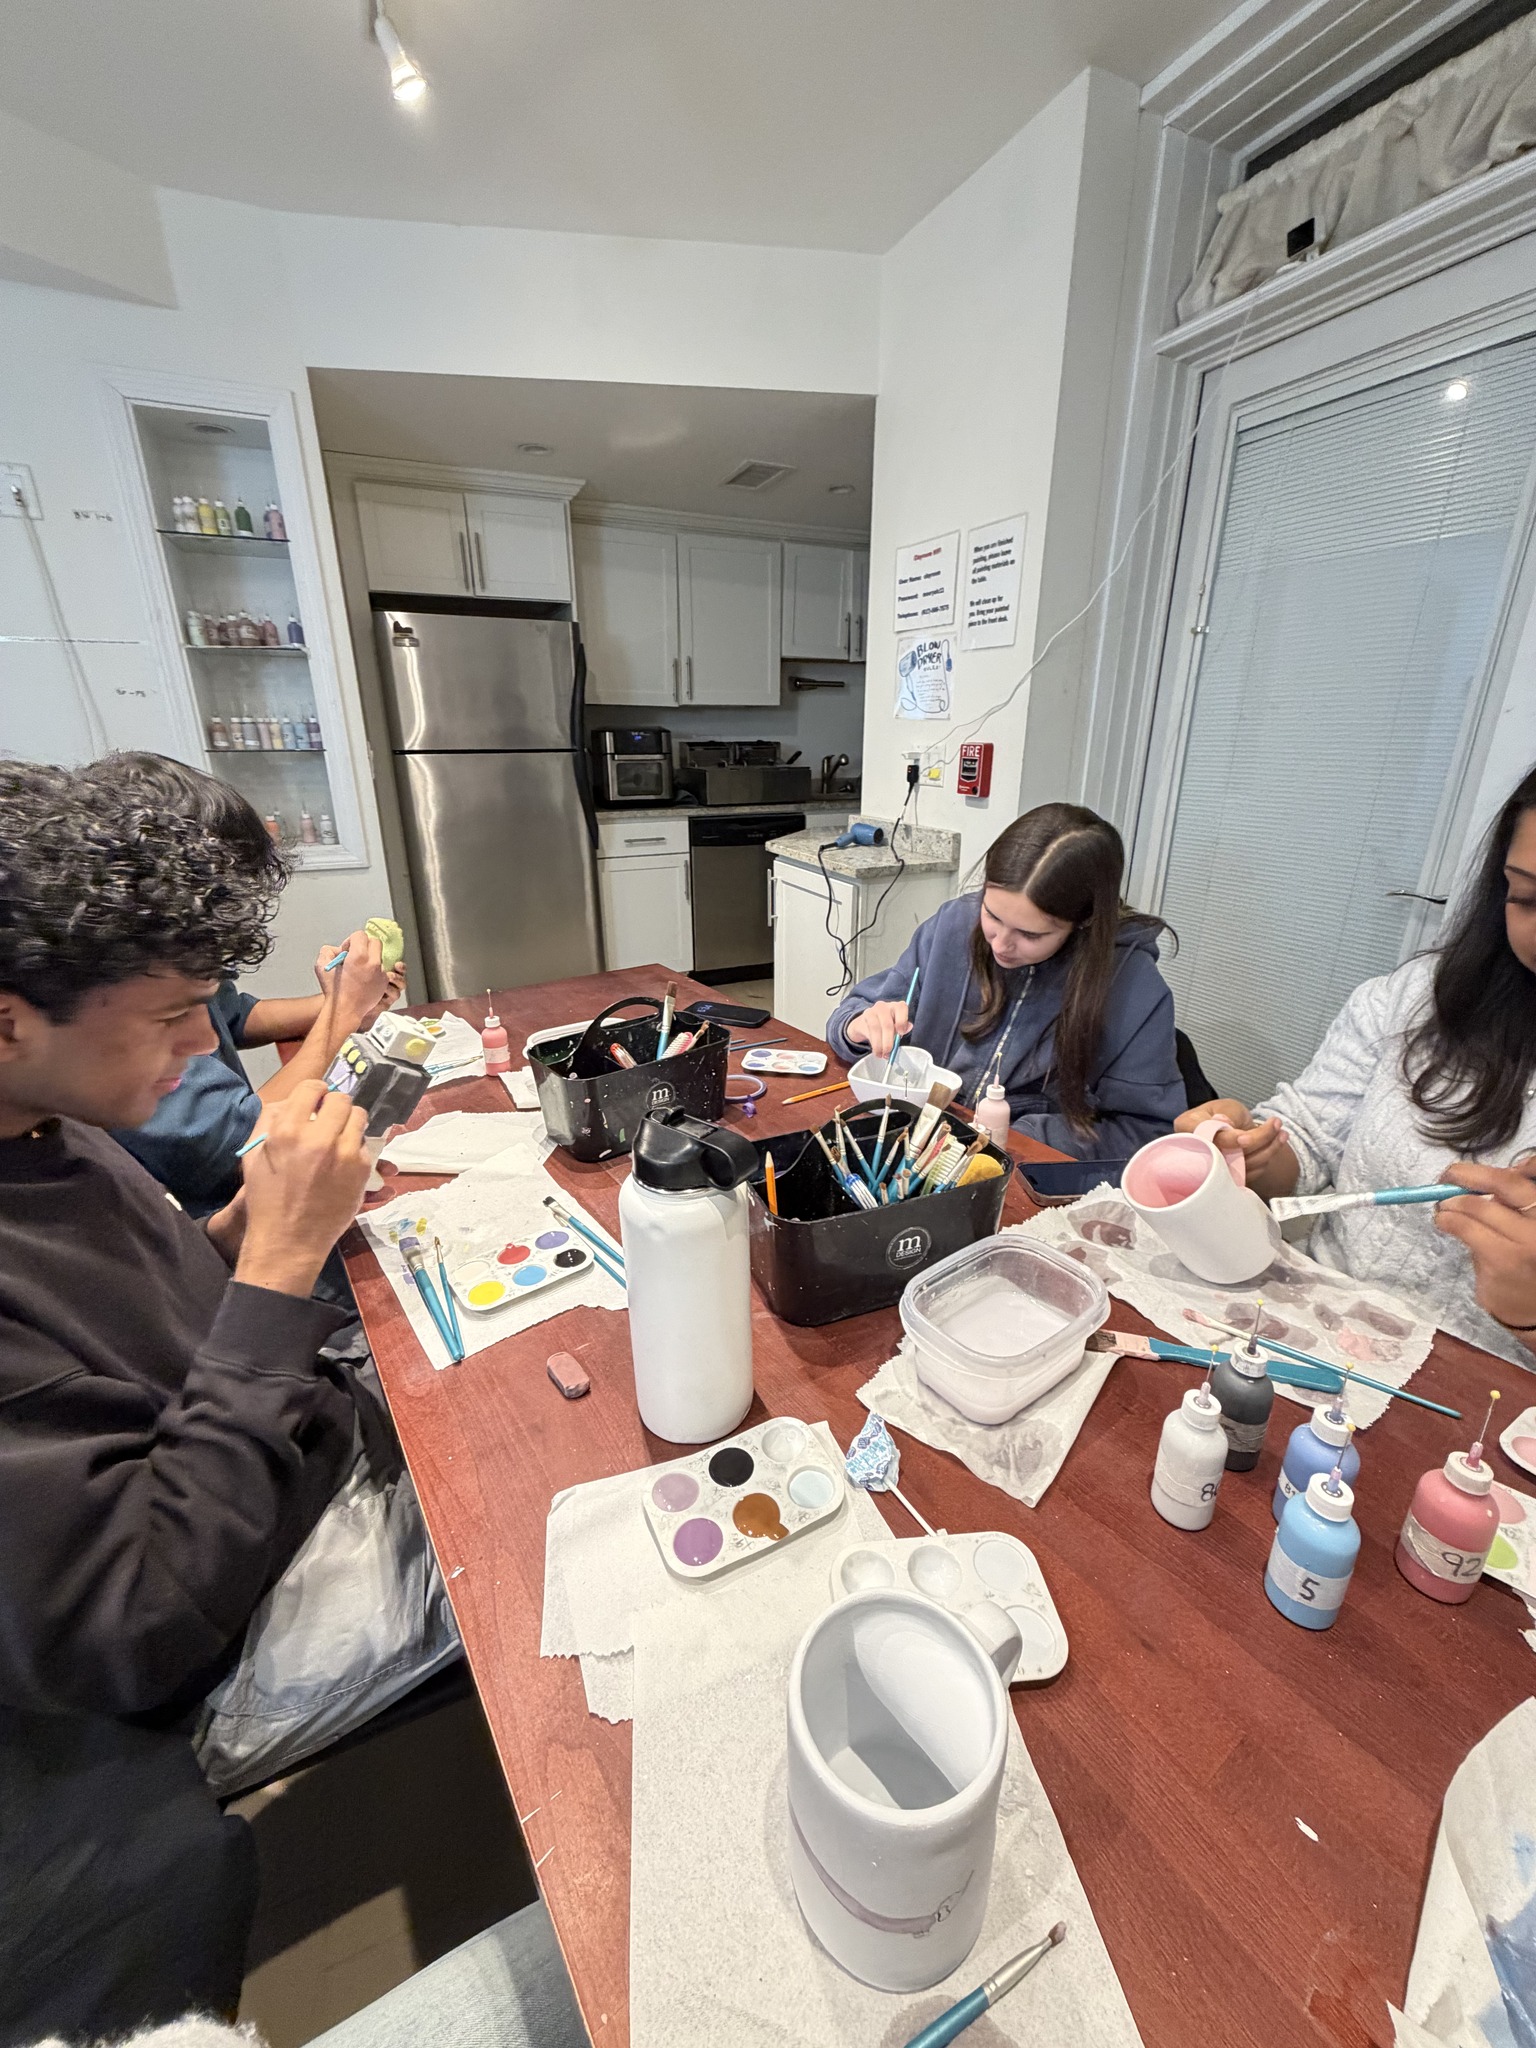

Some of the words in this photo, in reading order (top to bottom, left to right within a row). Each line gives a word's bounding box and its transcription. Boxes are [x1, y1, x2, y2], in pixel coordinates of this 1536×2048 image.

[917, 652, 942, 670] DRYER
[962, 745, 980, 757] FIRE
[652, 1088, 669, 1100] m
[897, 1235, 921, 1252] m
[895, 1247, 921, 1258] DESIGN
[1442, 1551, 1482, 1578] 92
[1298, 1577, 1320, 1602] 5
